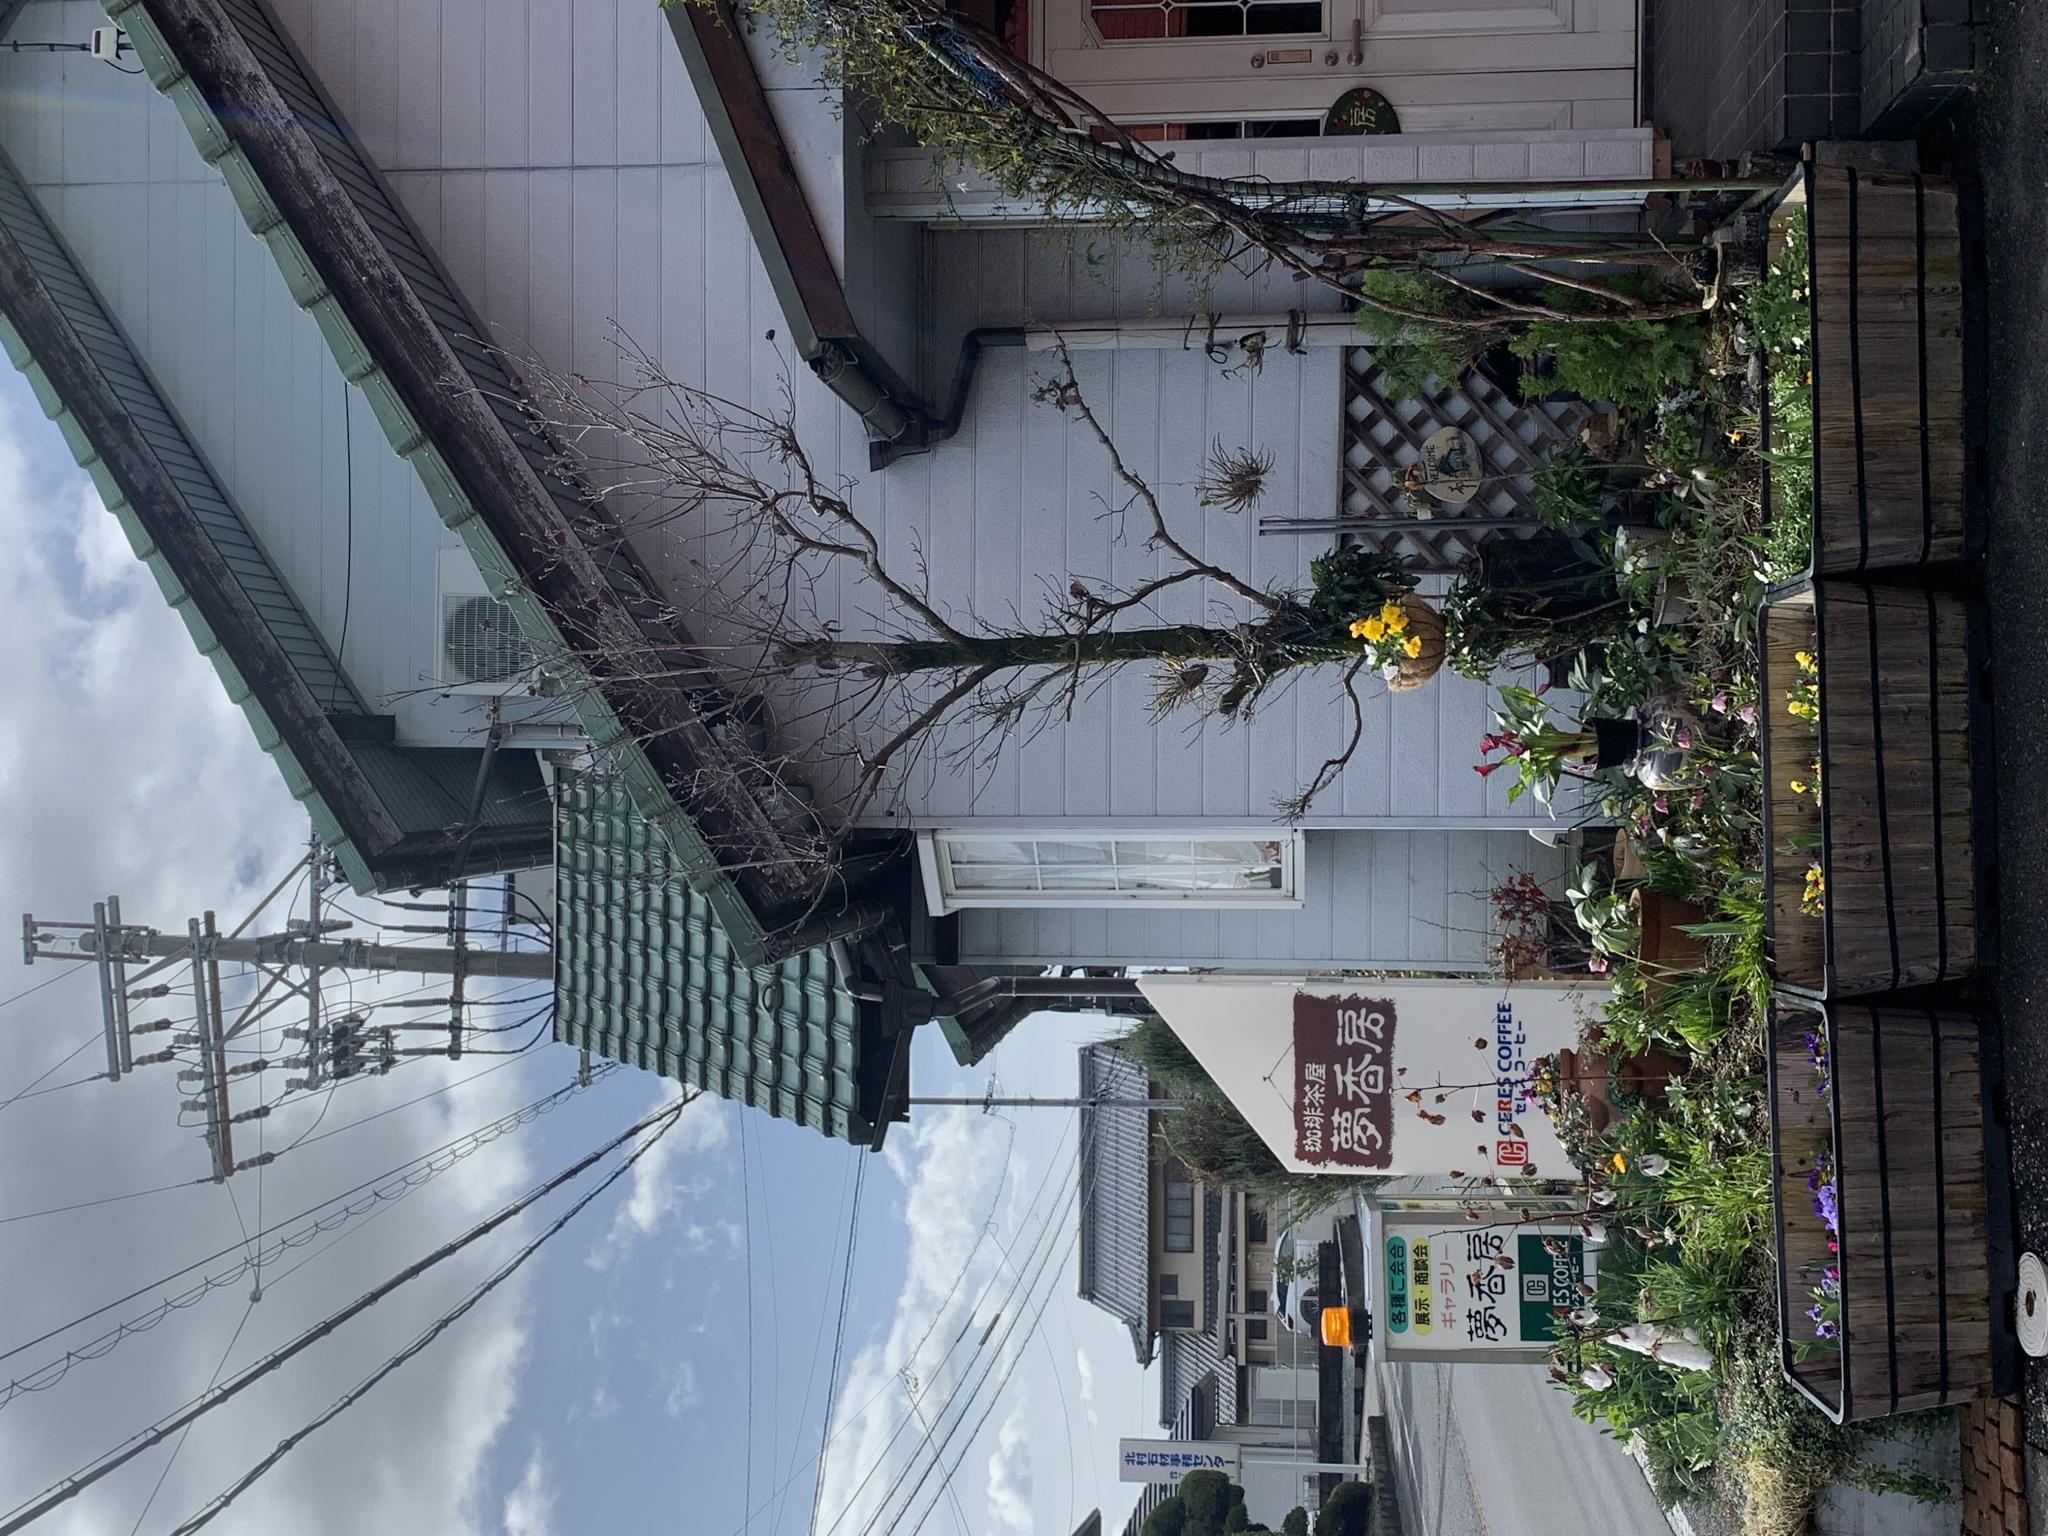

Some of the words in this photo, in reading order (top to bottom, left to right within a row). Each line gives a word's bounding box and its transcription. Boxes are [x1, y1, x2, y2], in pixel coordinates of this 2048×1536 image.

[1426, 444, 1439, 485] WELCOME
[1497, 1002, 1512, 1072] COFFEE
[1303, 1062, 1326, 1152] 珈琲茶屋
[1330, 1007, 1386, 1156] 夢香房
[1498, 1077, 1512, 1136] CERES
[1388, 1244, 1406, 1325] 各種ご会合
[1412, 1244, 1430, 1326] 展示・商談会
[1440, 1244, 1457, 1330] ギャラリー
[1466, 1232, 1508, 1342] 夢香房
[1552, 1240, 1570, 1287] COFFE
[1124, 1452, 1236, 1468] 北村石材事務センター
